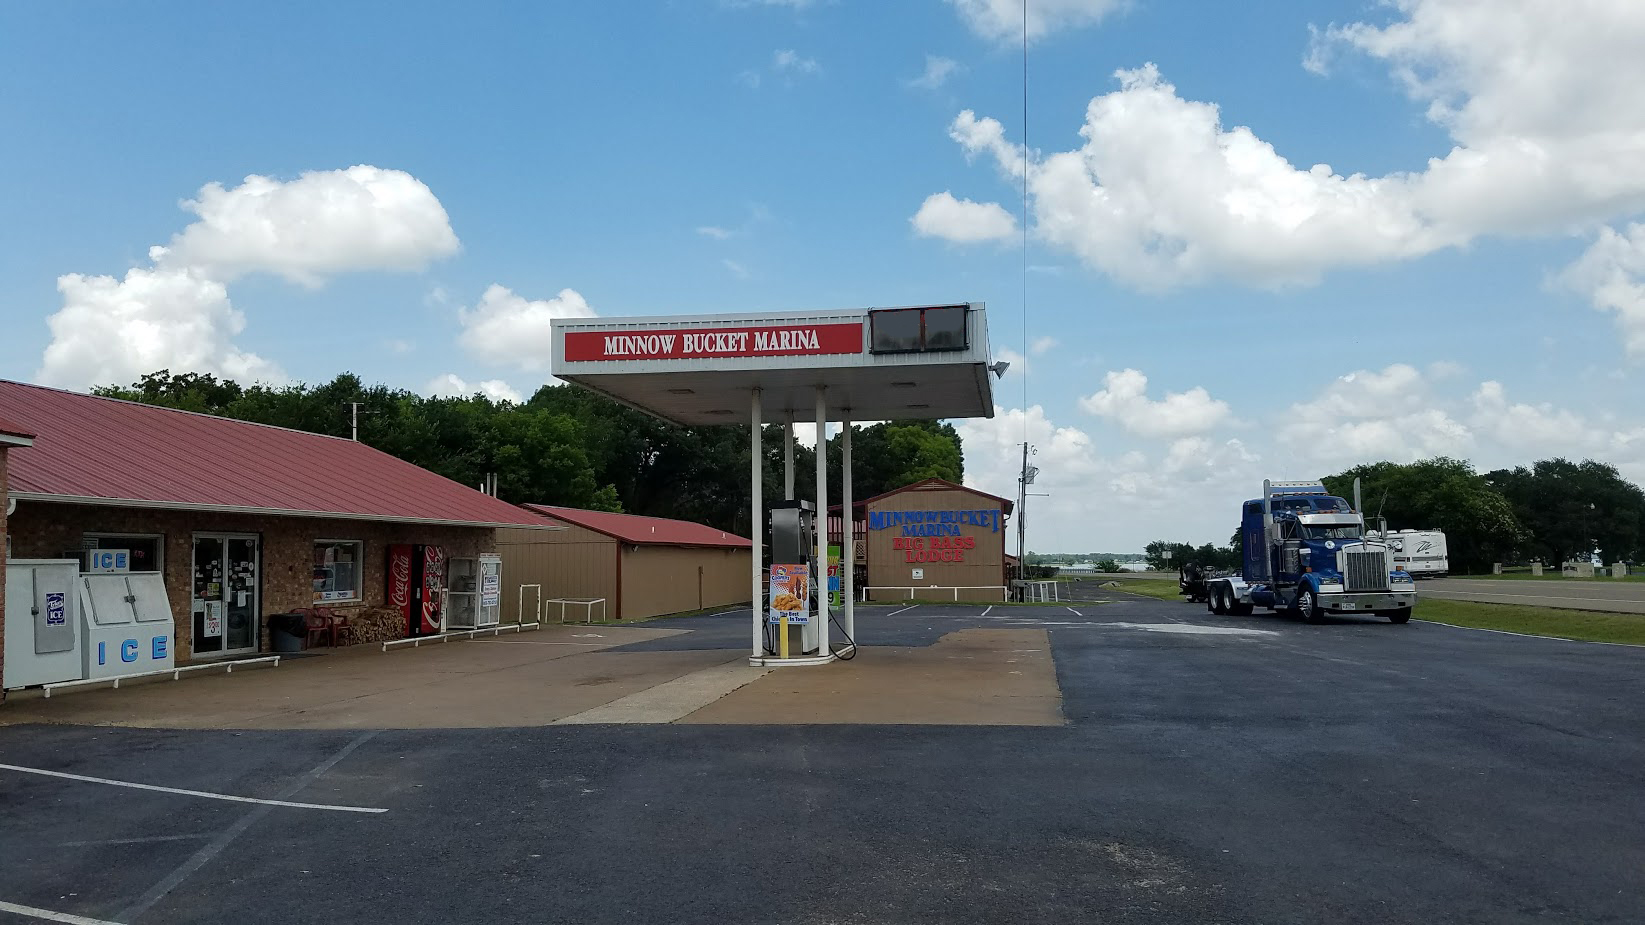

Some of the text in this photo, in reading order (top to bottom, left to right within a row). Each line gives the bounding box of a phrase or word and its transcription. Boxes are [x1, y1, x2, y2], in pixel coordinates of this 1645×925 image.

[603, 329, 821, 356] MINNOW BUCKET MARINA
[902, 523, 961, 537] MARINA
[892, 536, 976, 550] BIG BASS
[94, 552, 127, 569] ICE
[905, 549, 965, 563] LODGE
[50, 610, 63, 619] ICE
[98, 635, 168, 666] ICE
